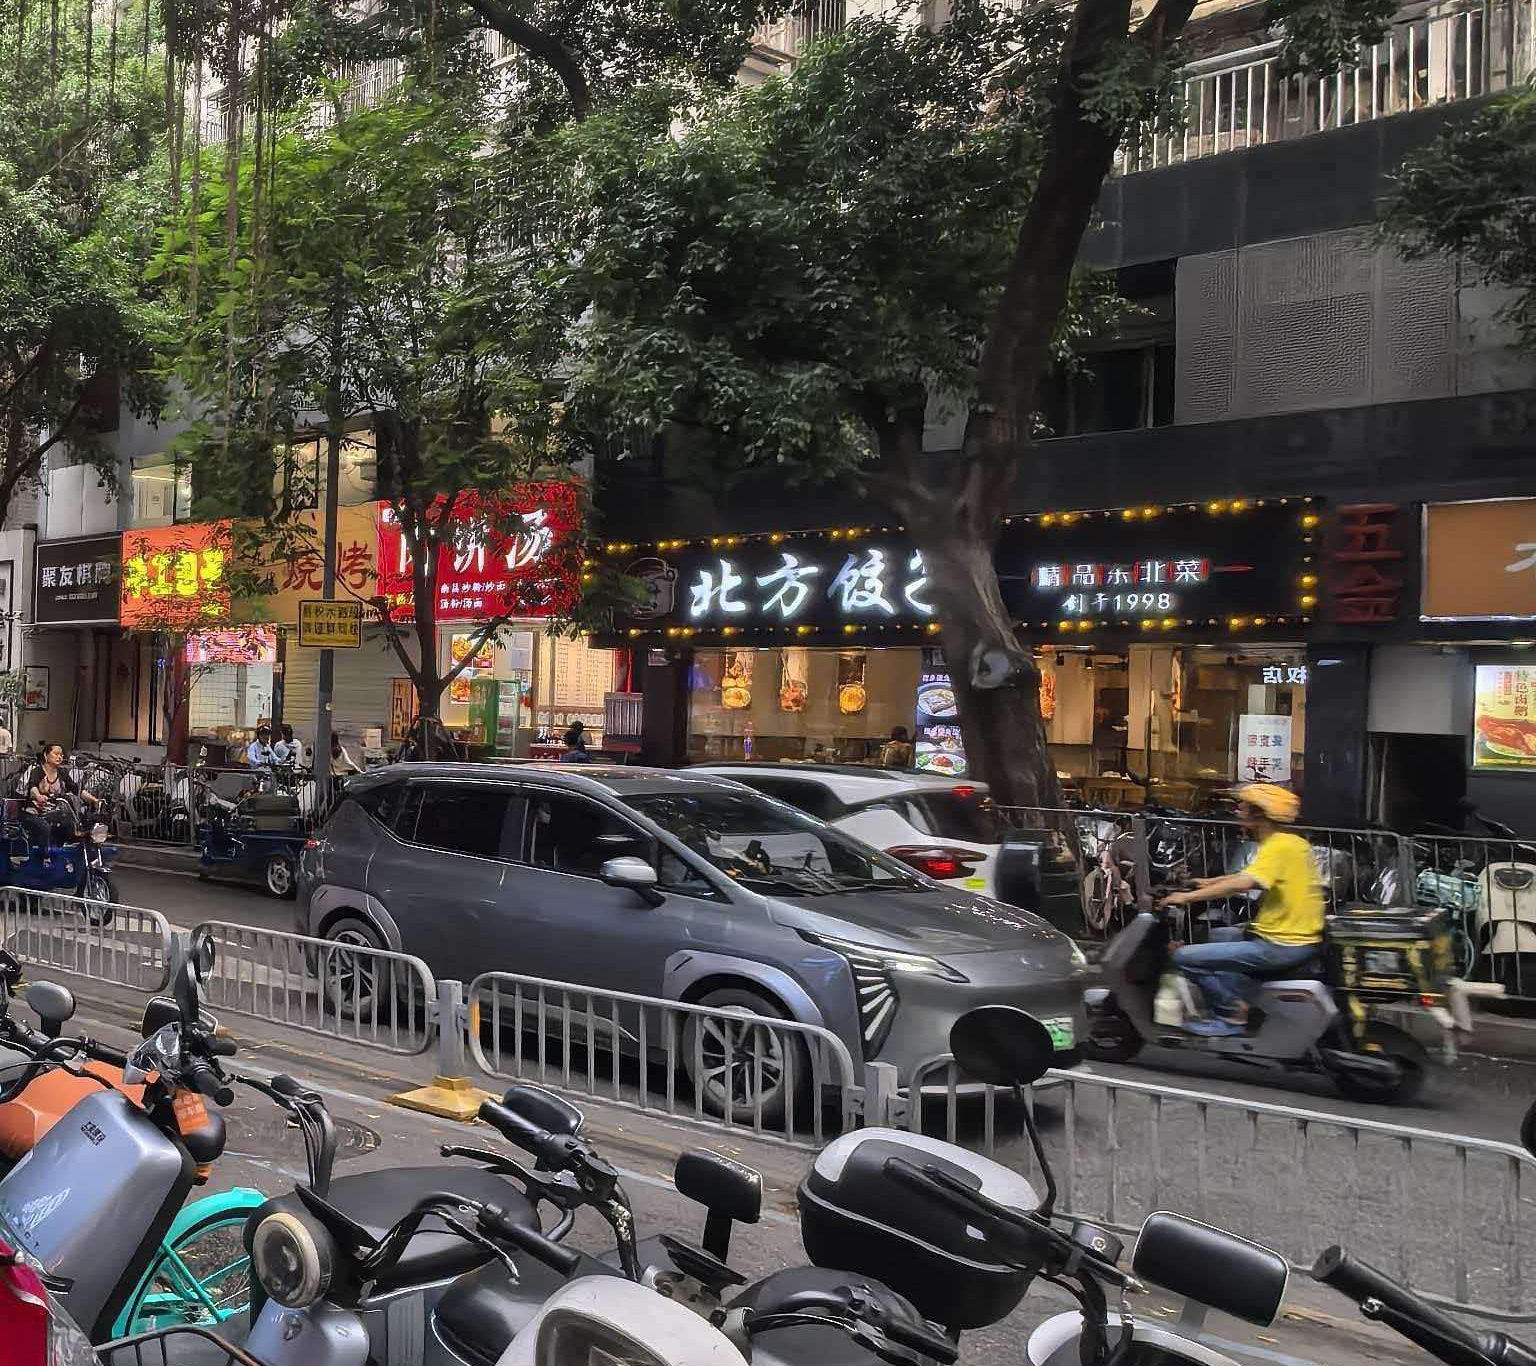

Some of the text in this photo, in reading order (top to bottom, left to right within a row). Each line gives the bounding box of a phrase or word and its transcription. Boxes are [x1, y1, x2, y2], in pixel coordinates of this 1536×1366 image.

[1038, 560, 1202, 587] 精品东北菜
[1330, 503, 1404, 624] 五金
